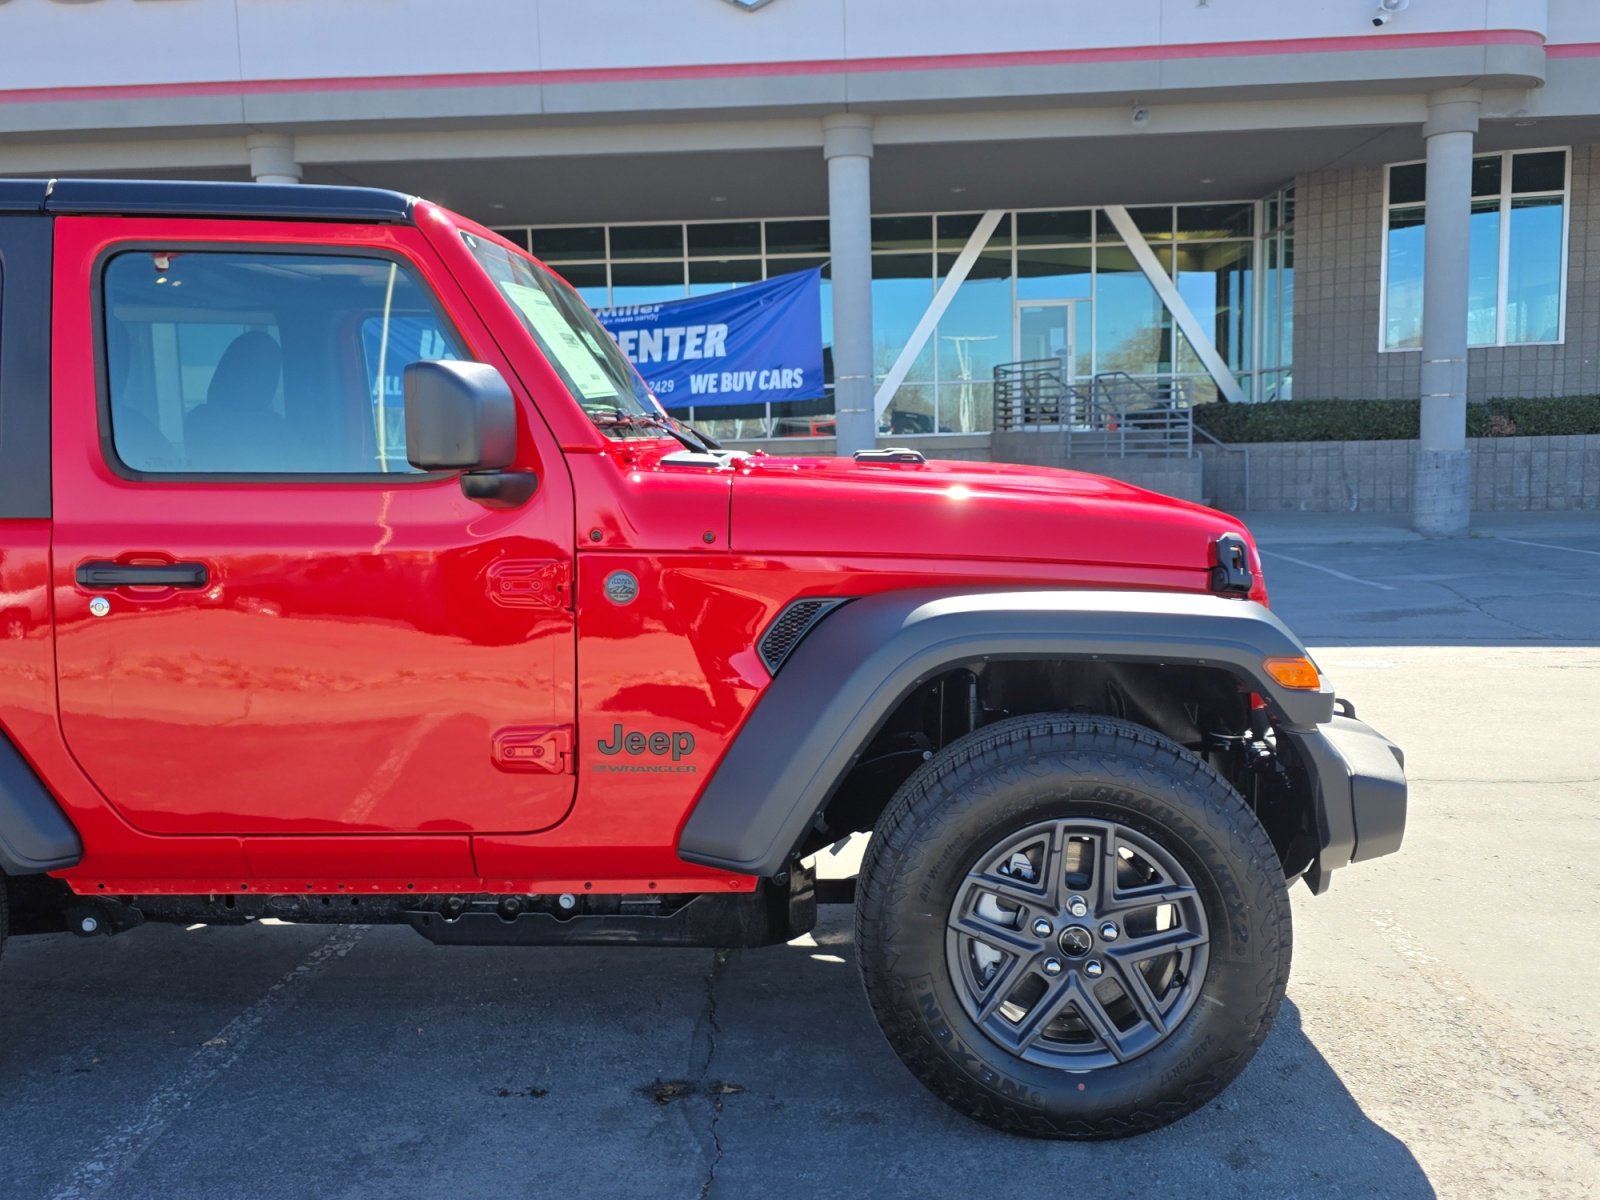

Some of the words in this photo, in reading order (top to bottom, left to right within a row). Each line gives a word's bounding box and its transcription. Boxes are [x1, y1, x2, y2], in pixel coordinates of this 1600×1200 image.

[608, 323, 728, 363] ENTER
[690, 373, 719, 394] WE
[720, 371, 758, 393] BUY
[758, 367, 804, 390] CARS
[597, 723, 696, 762] Jeep
[607, 764, 697, 773] WRANGLER
[916, 991, 1029, 1100] NEXEN
